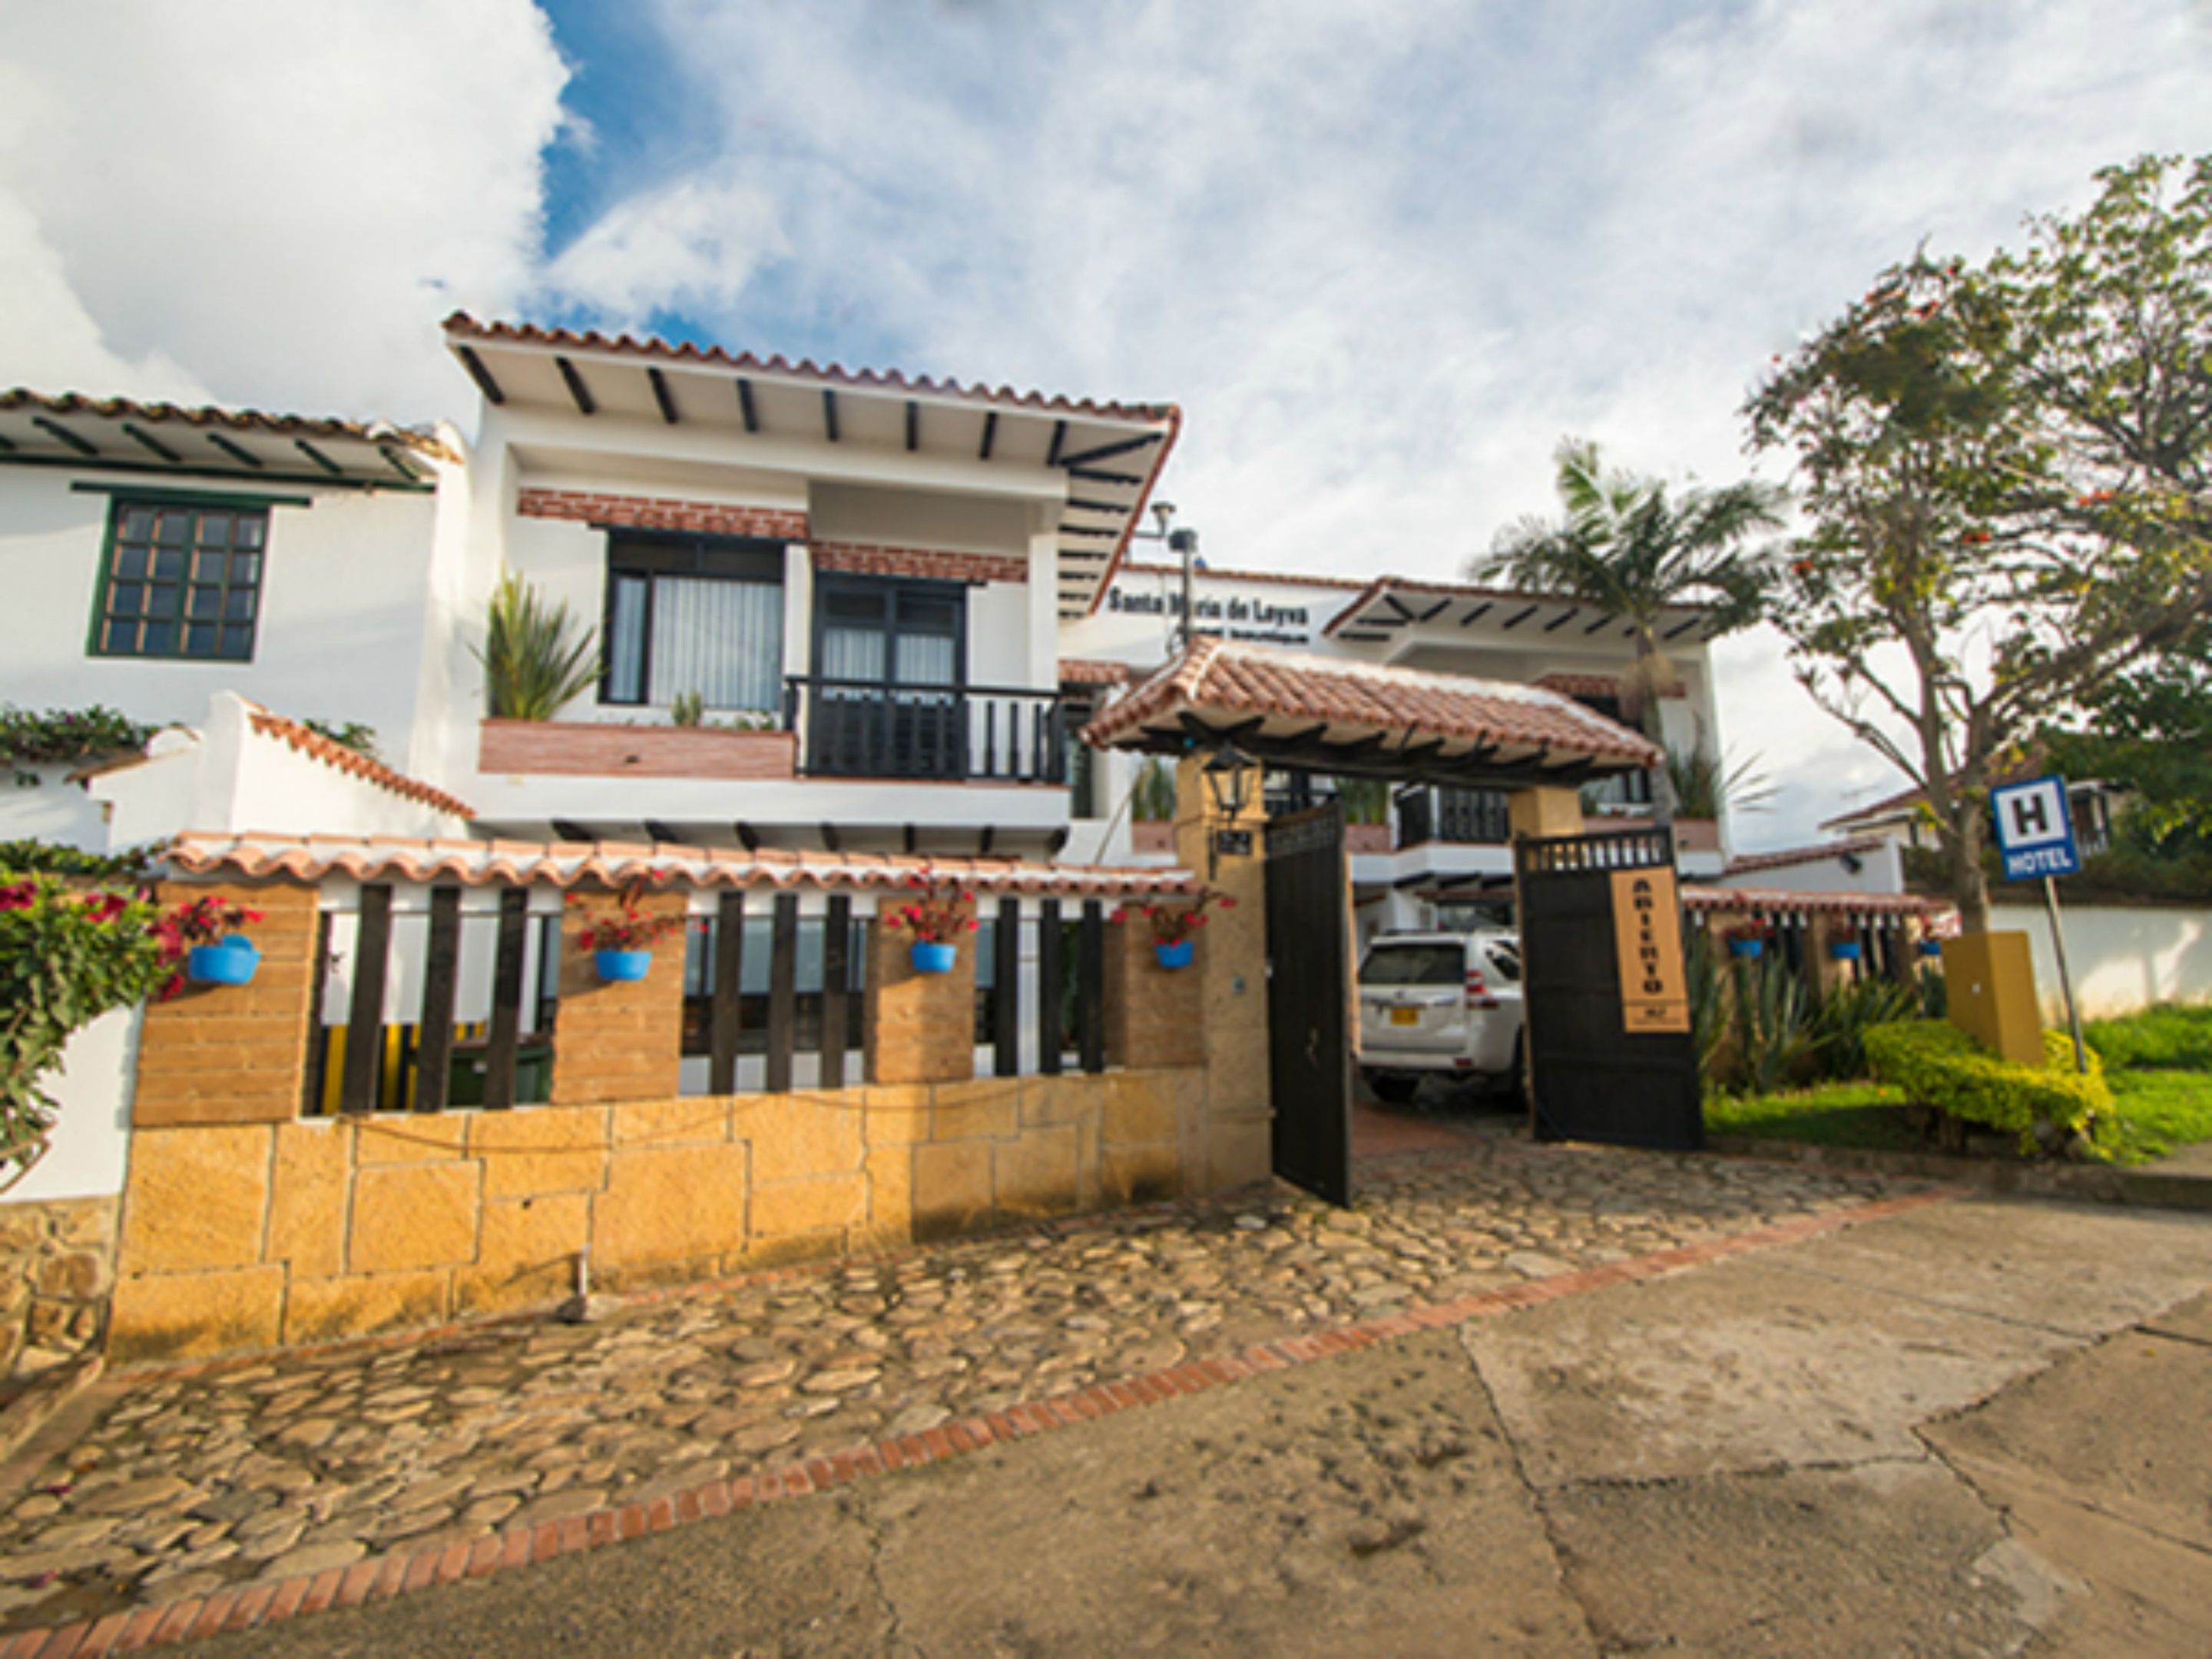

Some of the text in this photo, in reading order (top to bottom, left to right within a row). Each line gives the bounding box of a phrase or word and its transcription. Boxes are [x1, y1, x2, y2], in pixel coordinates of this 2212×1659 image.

[1109, 586, 1162, 612] Santa
[1227, 597, 1248, 619] de
[1253, 598, 1309, 626] Leyva
[2012, 793, 2049, 836] H
[2008, 846, 2073, 876] HOTEL
[1633, 878, 1664, 995] ABIERTO
